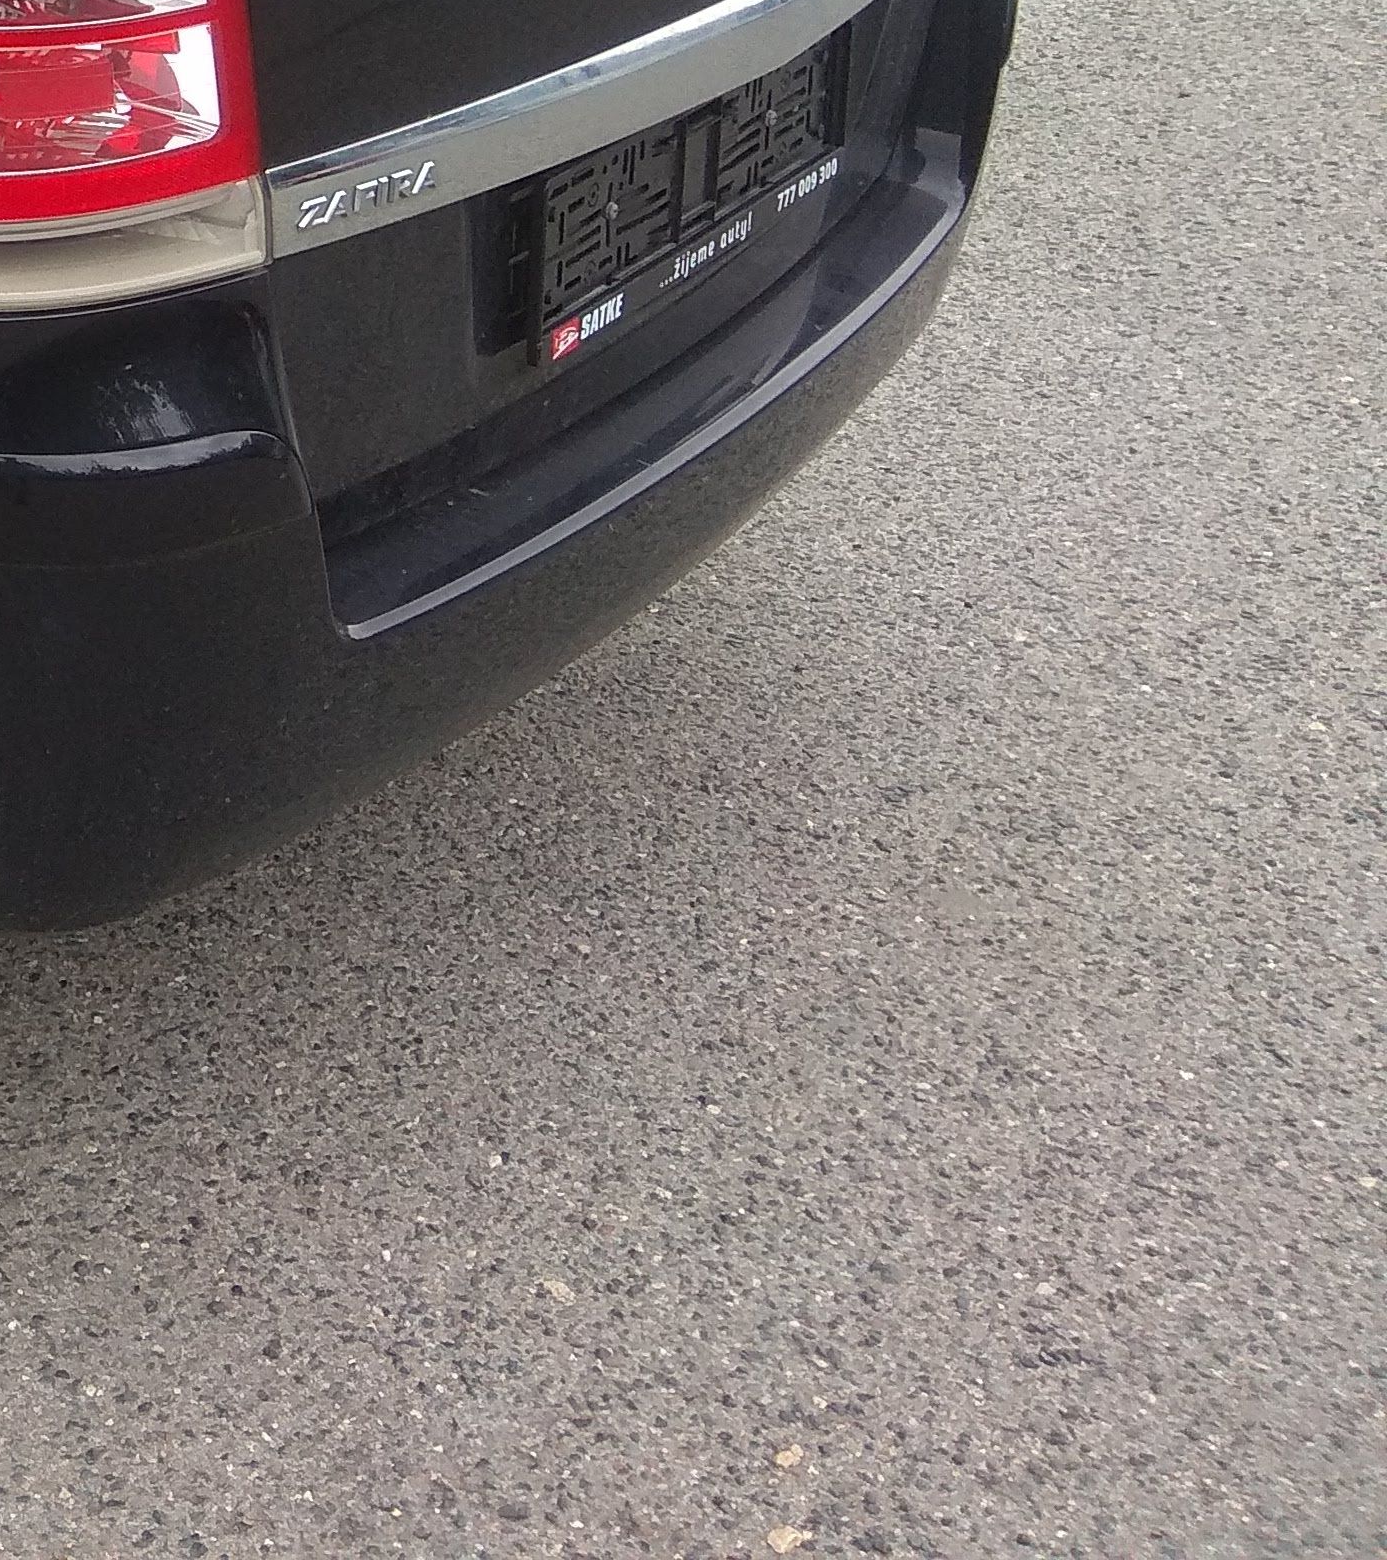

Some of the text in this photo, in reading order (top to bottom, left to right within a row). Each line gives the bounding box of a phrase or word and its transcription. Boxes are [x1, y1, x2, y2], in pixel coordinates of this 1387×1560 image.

[298, 160, 436, 230] ZAFIRA
[580, 292, 624, 340] SATKE
[777, 183, 797, 212] 777
[798, 171, 818, 198] 009
[818, 157, 838, 185] 300
